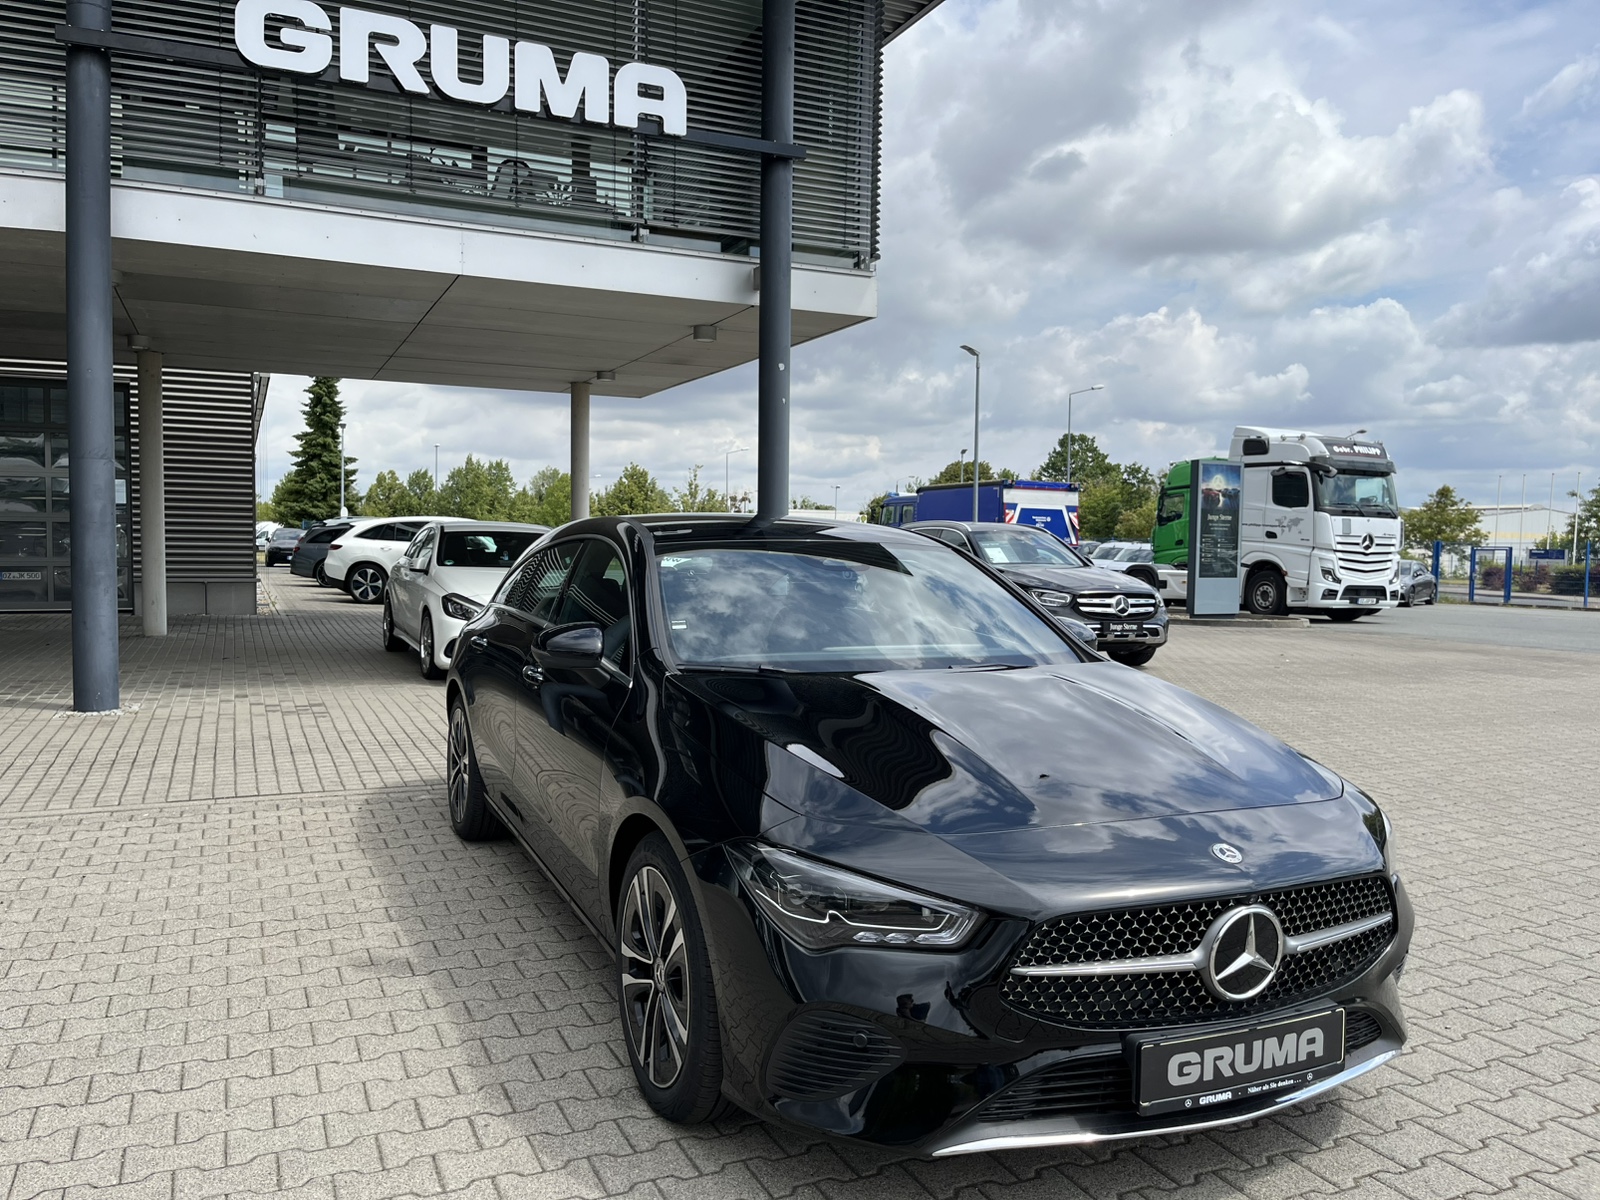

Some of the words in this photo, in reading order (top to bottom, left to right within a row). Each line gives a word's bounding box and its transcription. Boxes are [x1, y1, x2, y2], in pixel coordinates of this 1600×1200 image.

[234, 0, 687, 136] GRUMA
[1353, 445, 1381, 456] PHILIPP
[1167, 1027, 1324, 1087] GRUMA
[1199, 1091, 1232, 1105] GRUMA
[1247, 1085, 1262, 1094] Näher
[1269, 1081, 1277, 1089] Sie
